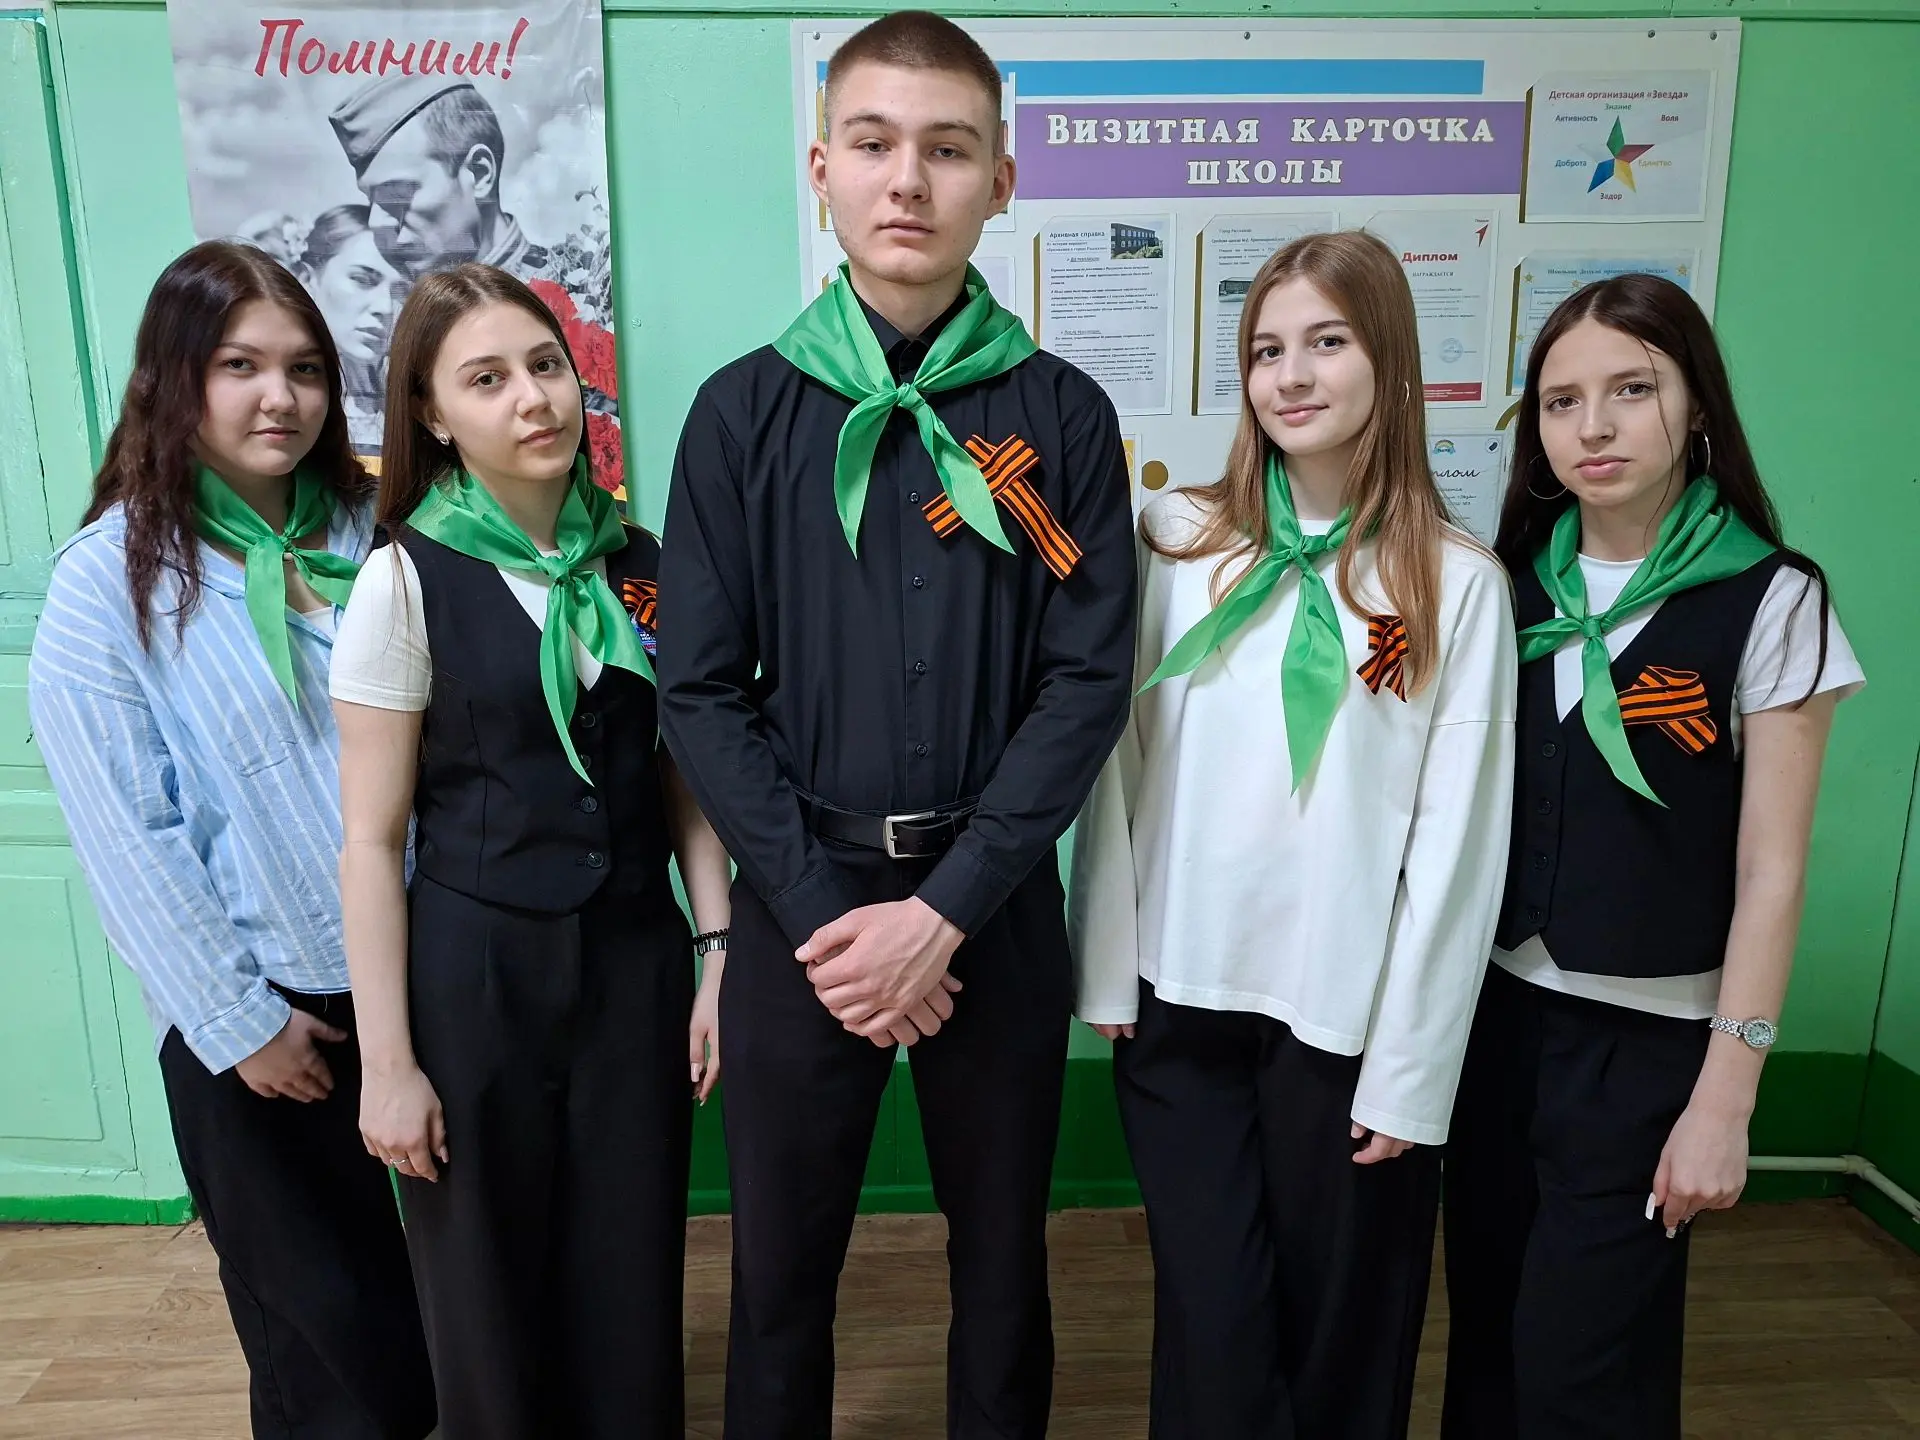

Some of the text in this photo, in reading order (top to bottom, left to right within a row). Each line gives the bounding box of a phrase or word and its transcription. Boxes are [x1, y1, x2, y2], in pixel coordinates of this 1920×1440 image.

[254, 17, 530, 80] Помним!
[1549, 90, 1688, 100] Детская организация «Звезда»
[1555, 114, 1598, 122] Активность
[1660, 114, 1679, 122] Воля
[1555, 159, 1587, 168] Доброта
[1638, 159, 1672, 167] Единство
[1600, 192, 1622, 200] Задор
[1401, 252, 1458, 263] Диплом
